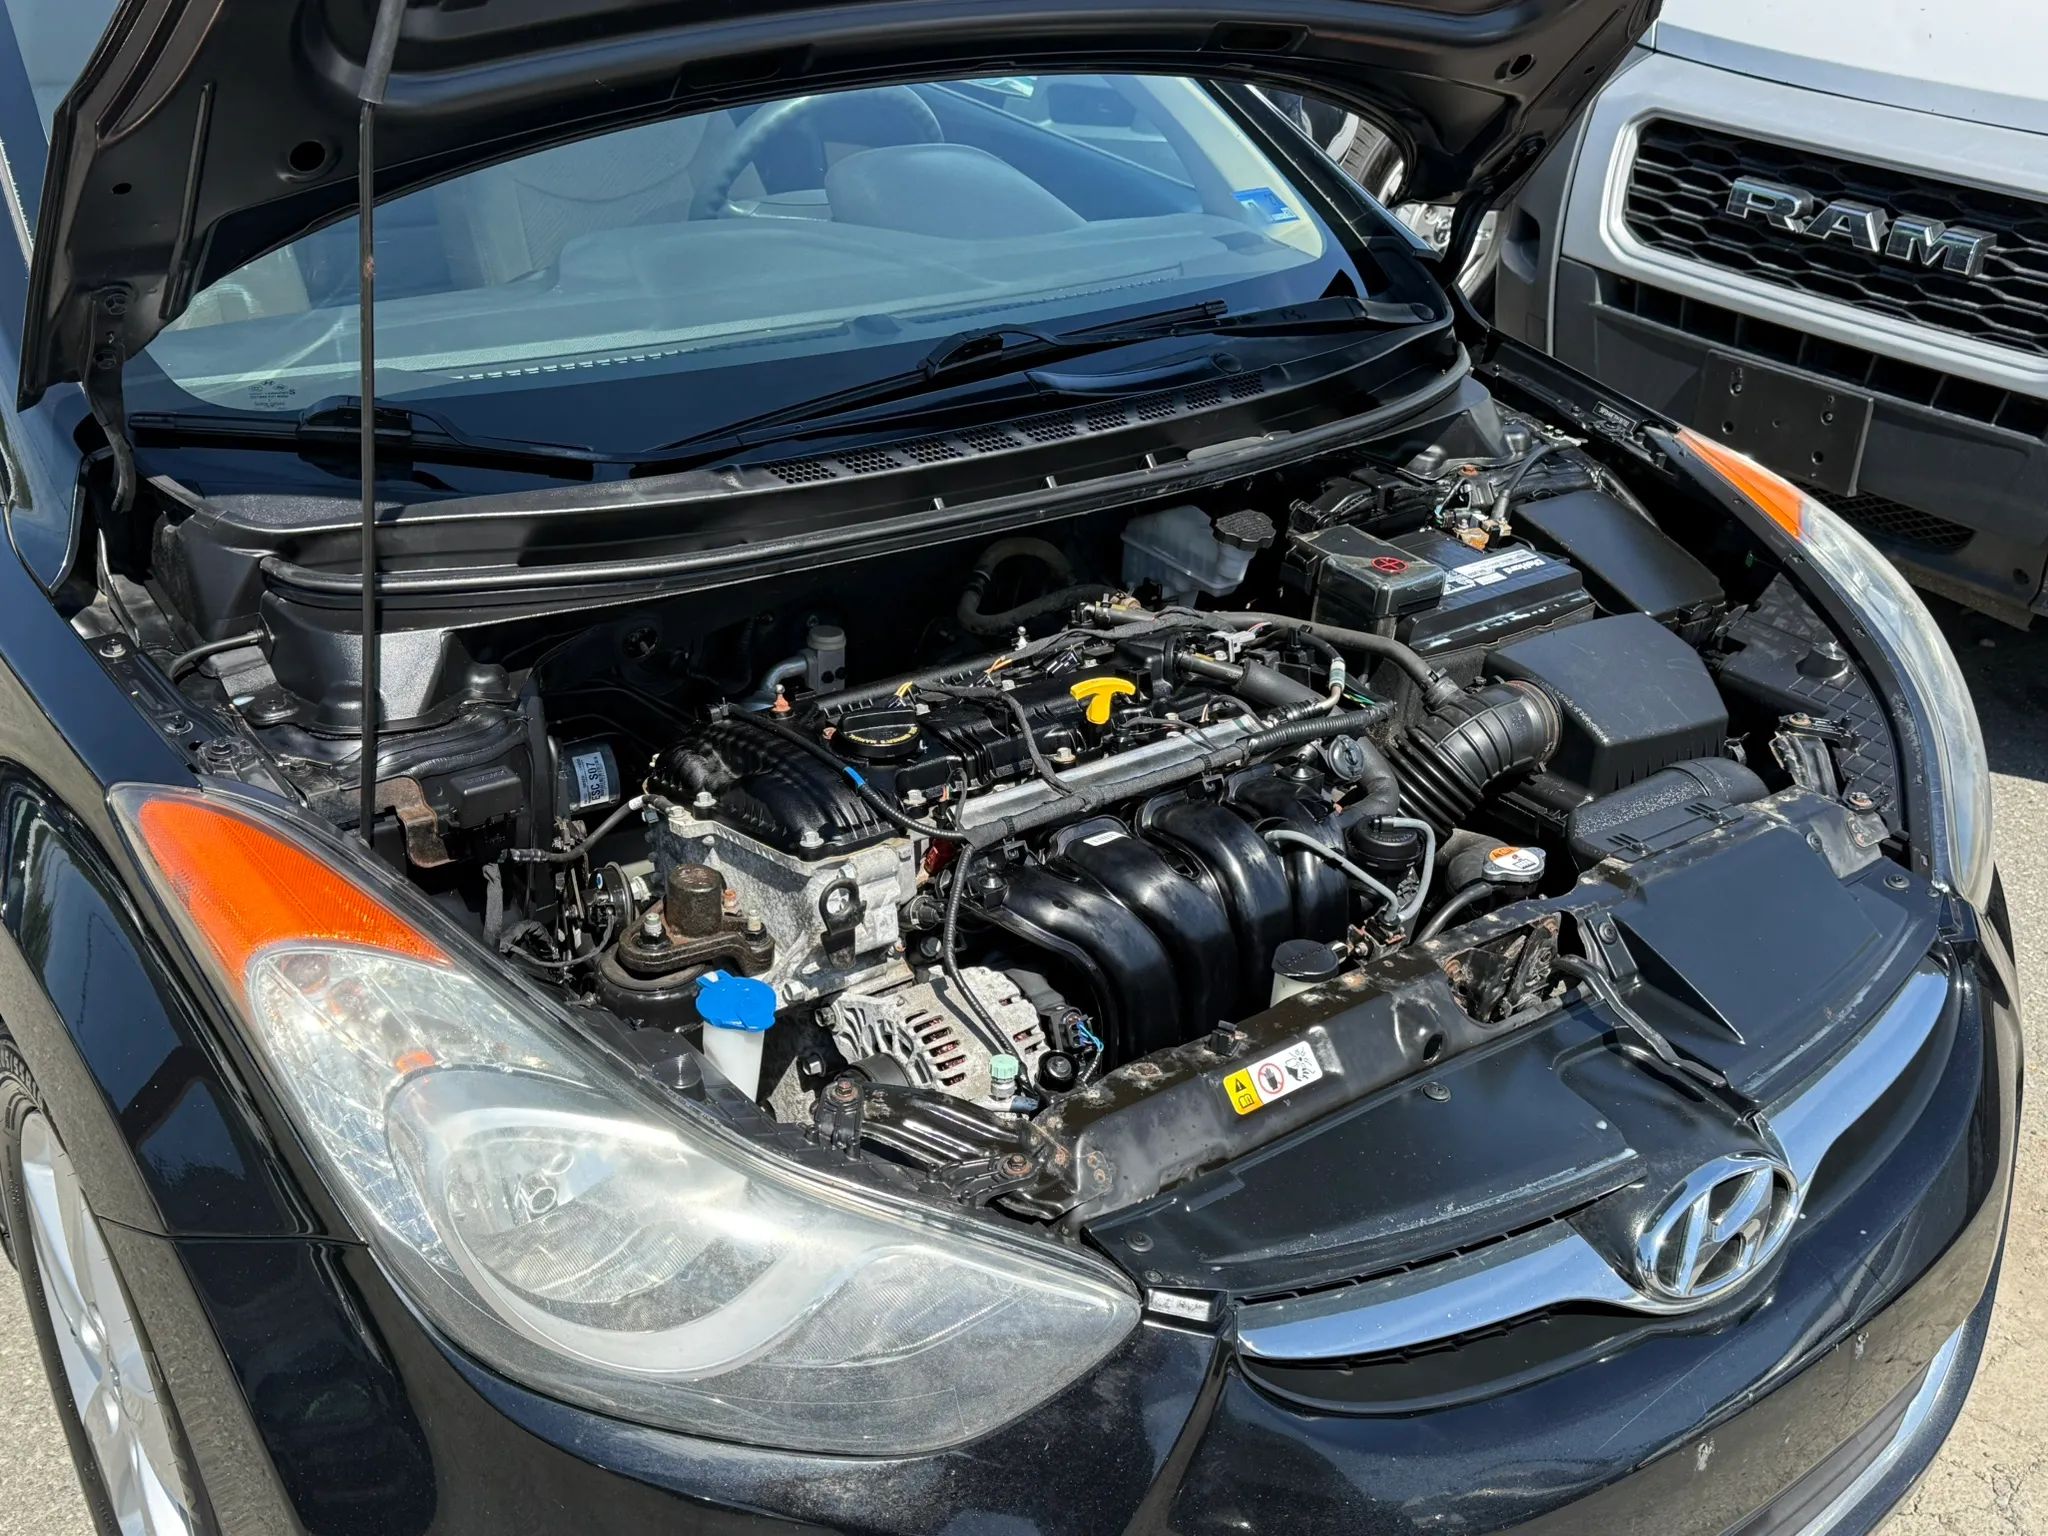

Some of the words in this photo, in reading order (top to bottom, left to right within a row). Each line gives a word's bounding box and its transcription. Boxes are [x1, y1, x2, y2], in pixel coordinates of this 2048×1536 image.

[1725, 175, 1998, 279] RAM
[586, 762, 599, 781] S07
[591, 783, 601, 801] ESC
